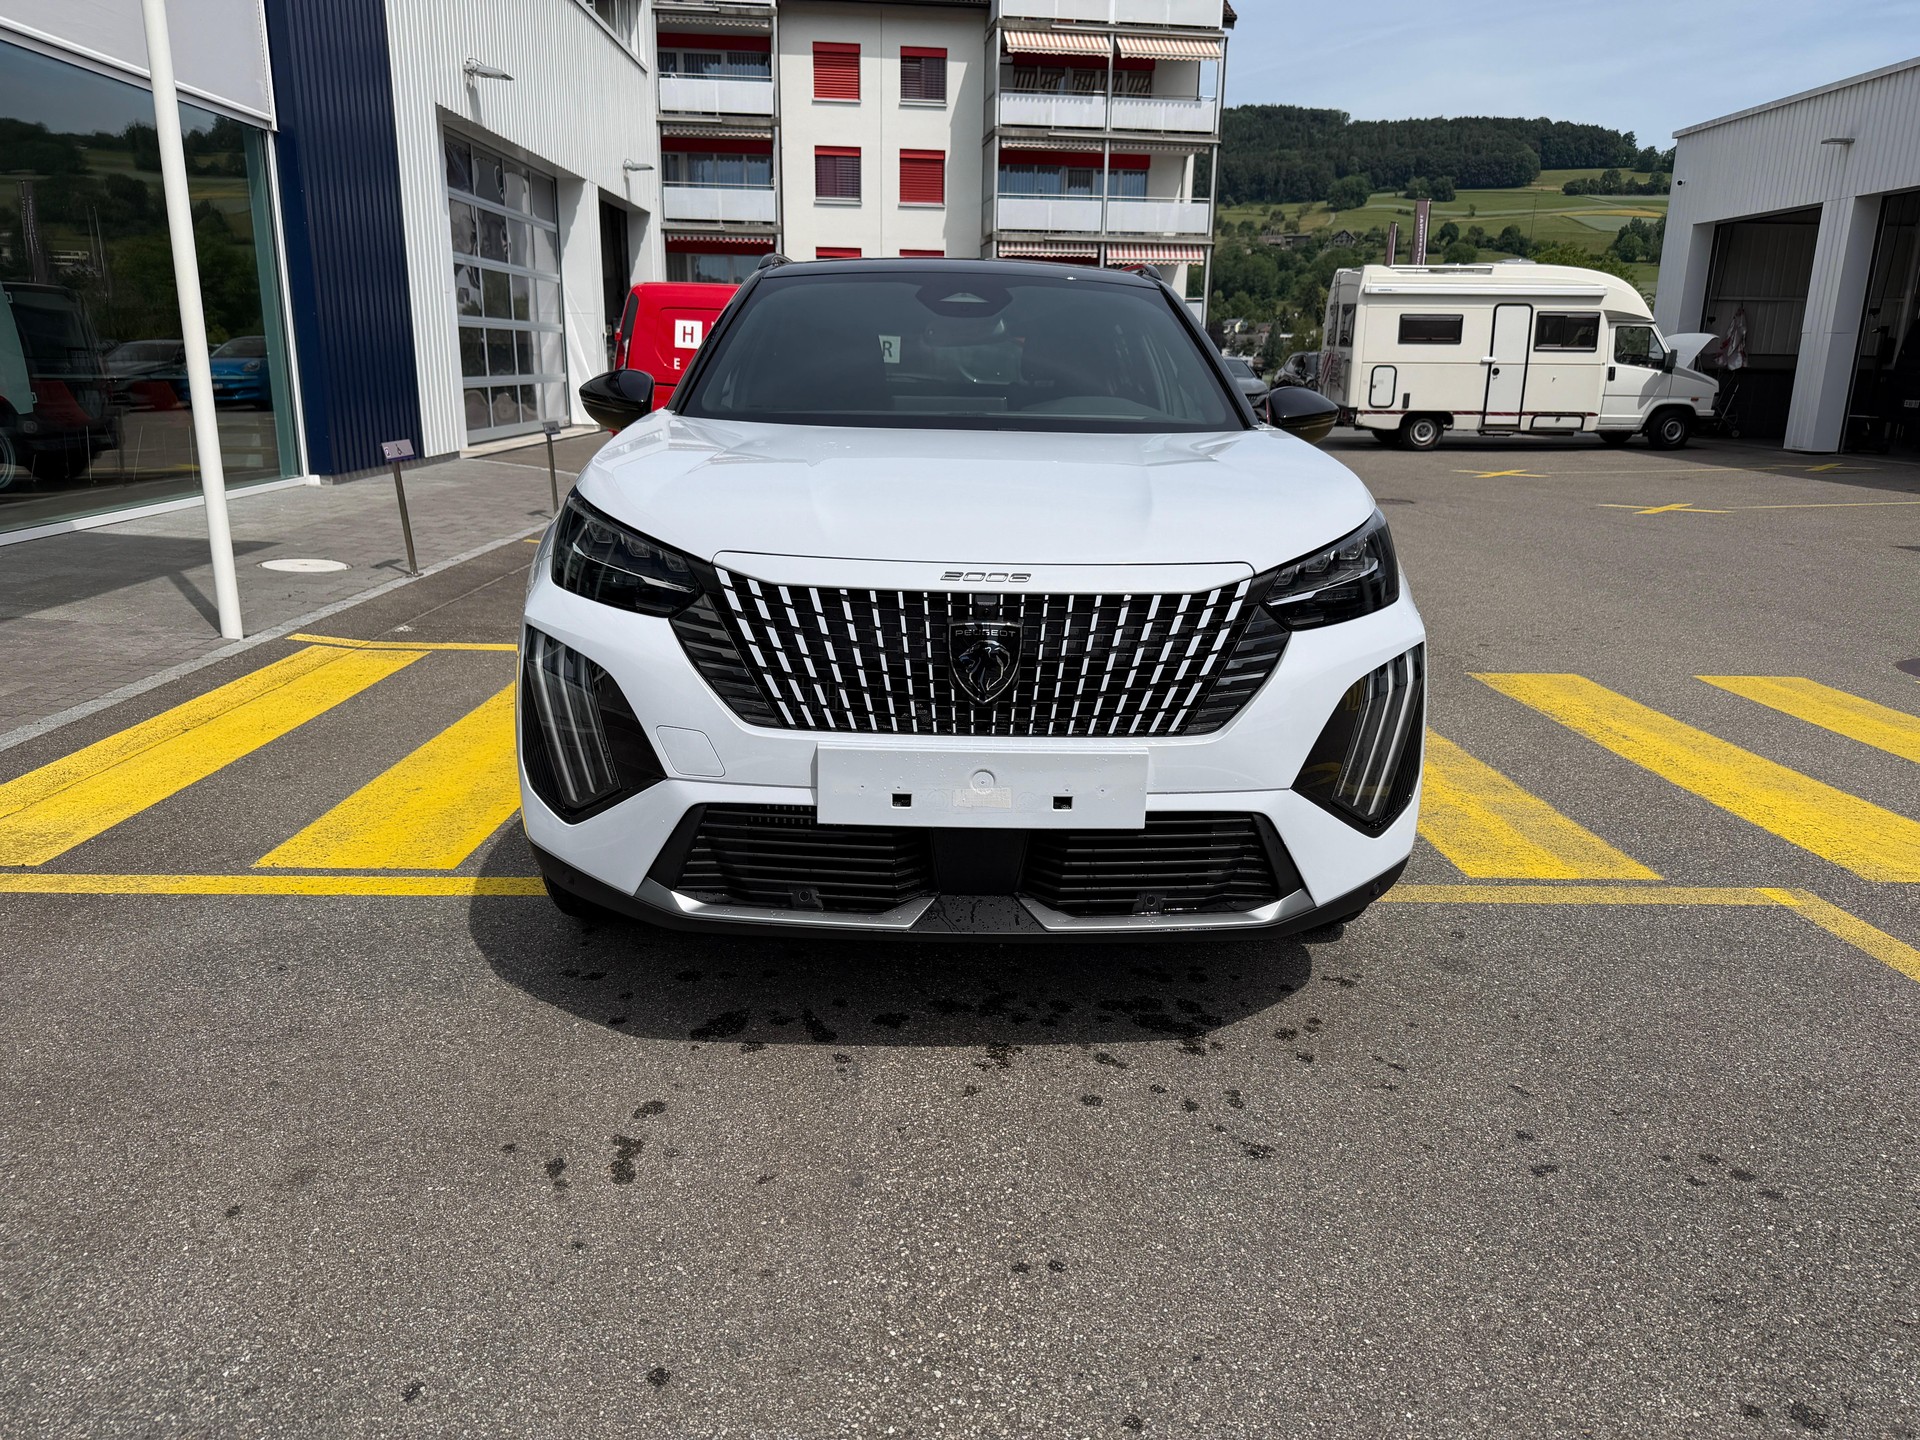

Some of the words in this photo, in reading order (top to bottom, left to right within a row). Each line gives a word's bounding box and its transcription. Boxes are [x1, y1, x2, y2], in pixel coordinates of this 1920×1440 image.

[682, 325, 695, 344] H
[882, 340, 893, 358] R
[940, 571, 1032, 583] 2008
[955, 628, 1017, 638] PEUGEOT
